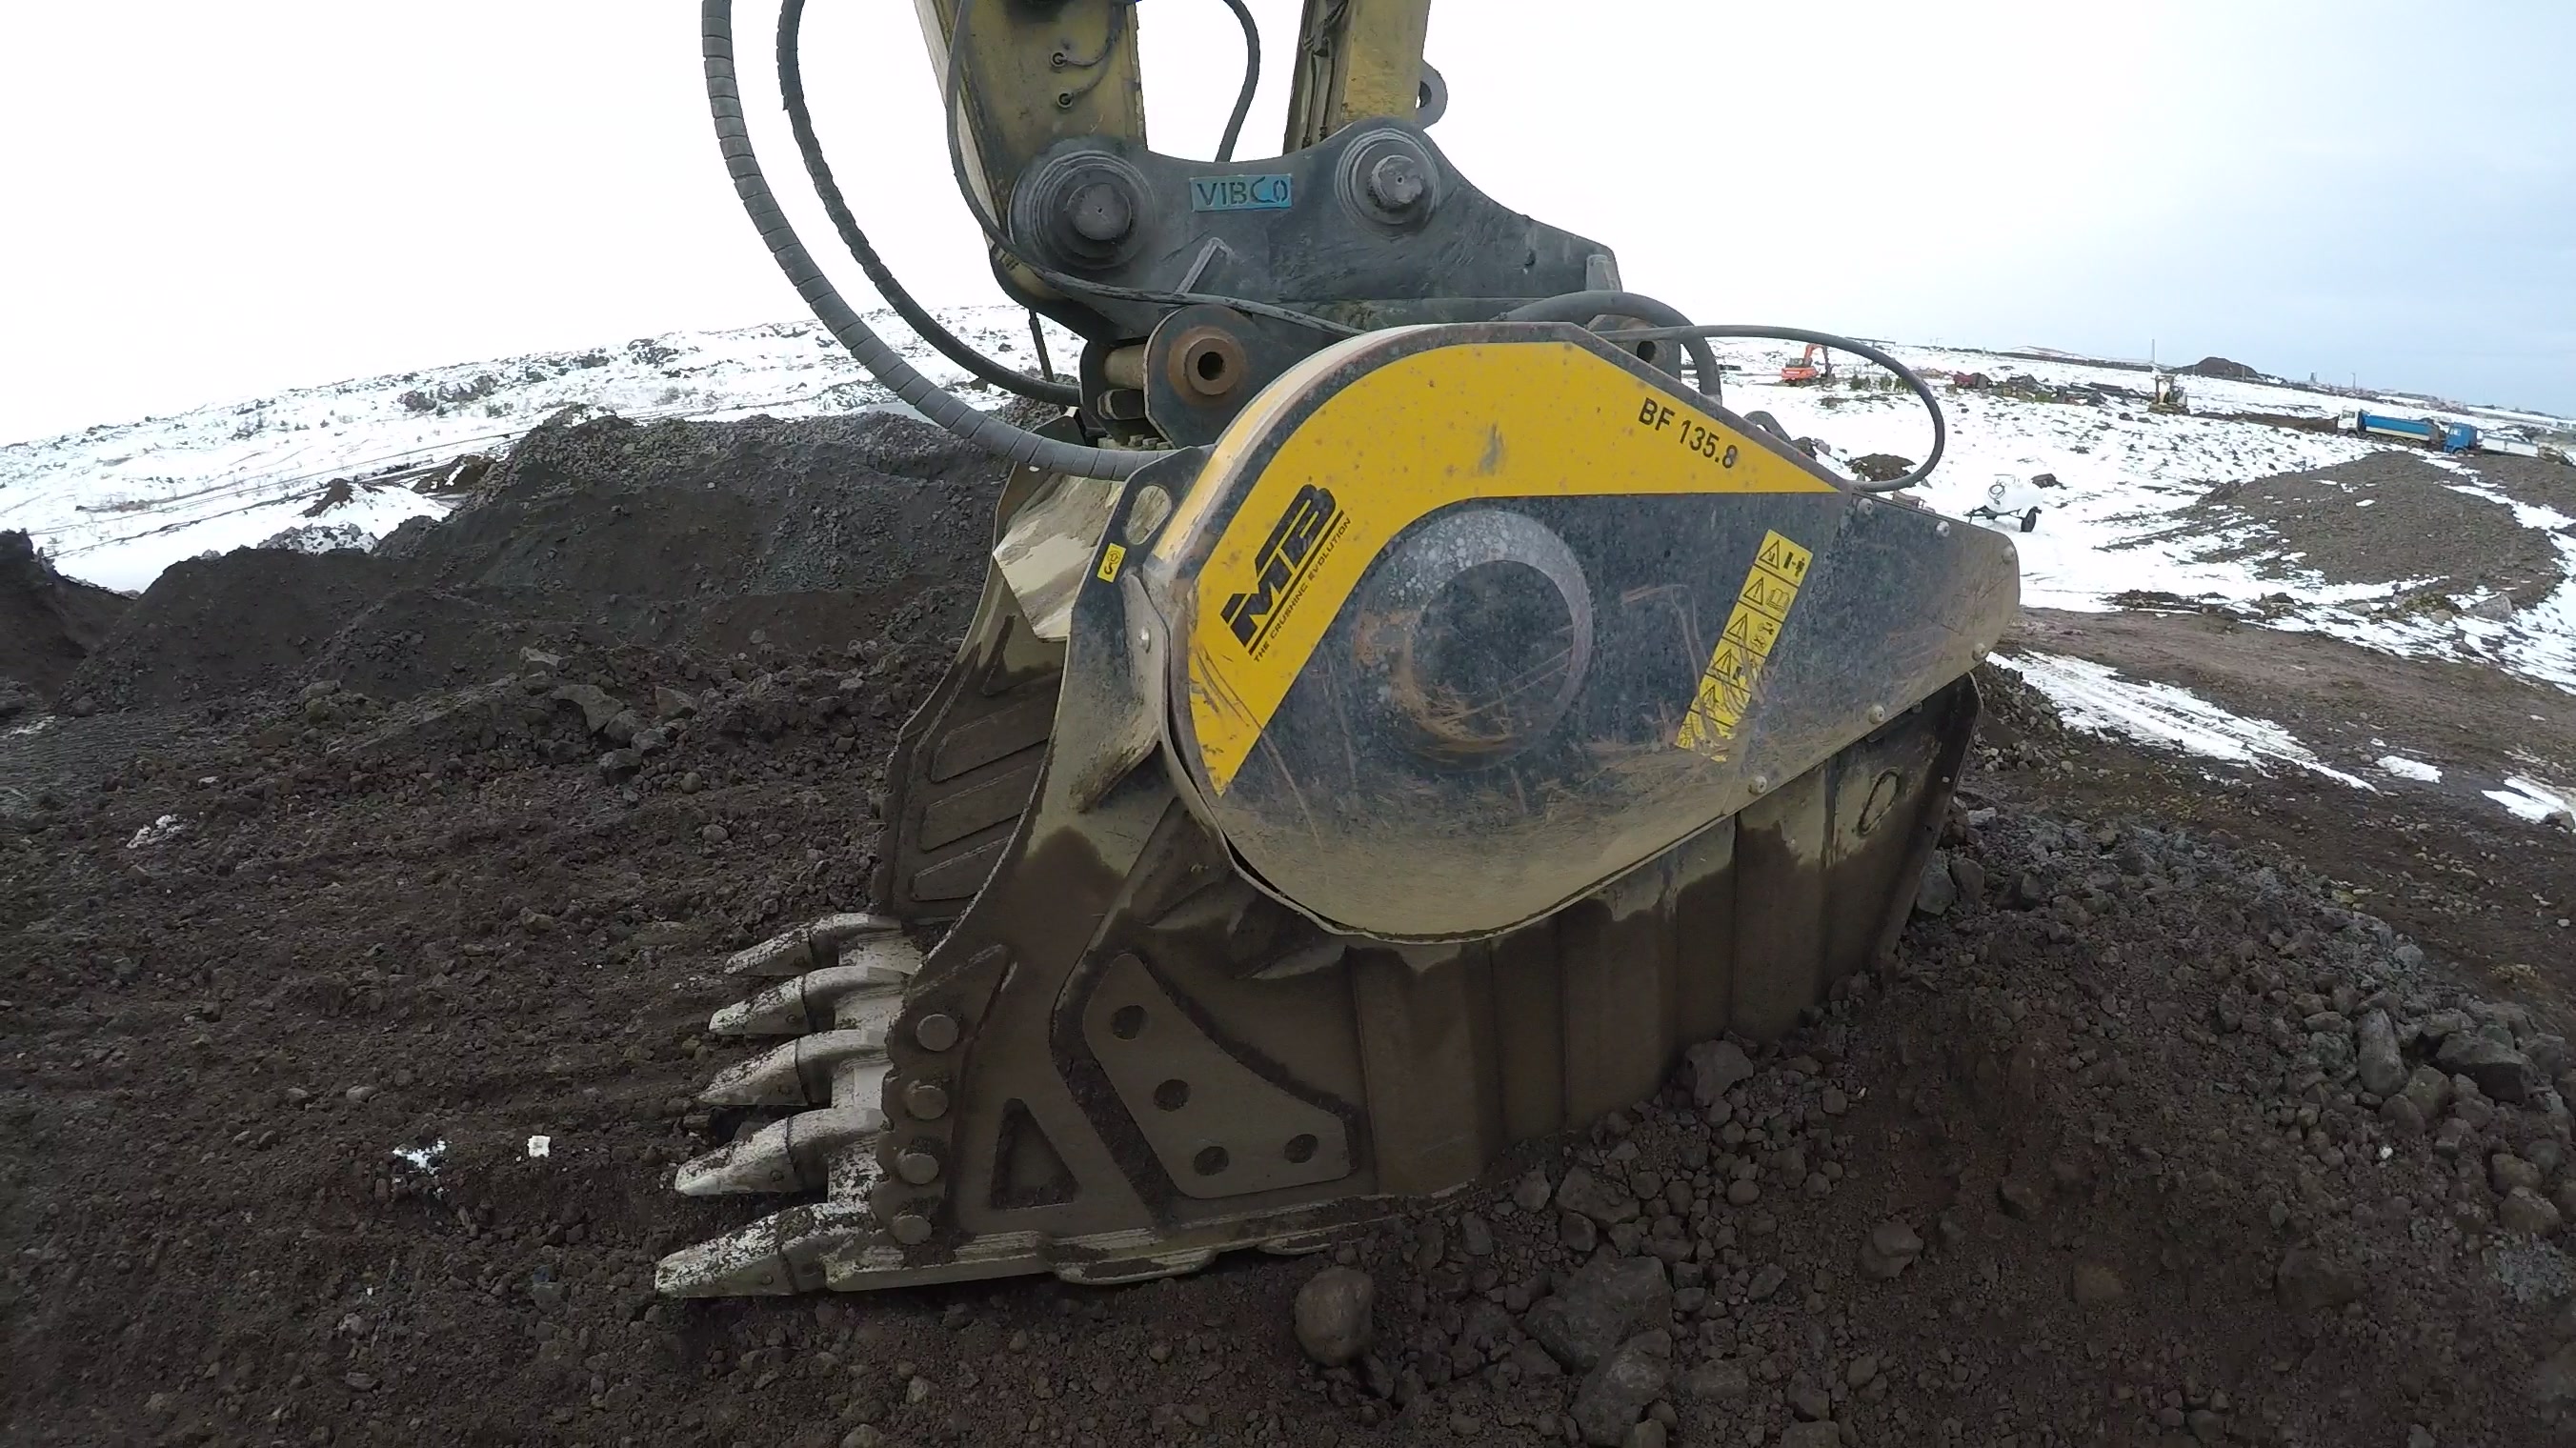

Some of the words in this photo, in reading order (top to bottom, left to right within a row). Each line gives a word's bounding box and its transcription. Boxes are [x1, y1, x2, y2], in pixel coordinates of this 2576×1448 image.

[1197, 176, 1288, 206] VIBCO
[1638, 396, 1676, 432] BF
[1680, 419, 1739, 469] 135.8
[1254, 640, 1270, 663] THE
[1270, 582, 1308, 639] CRUSHING
[1307, 517, 1351, 582] EVOLUTION
